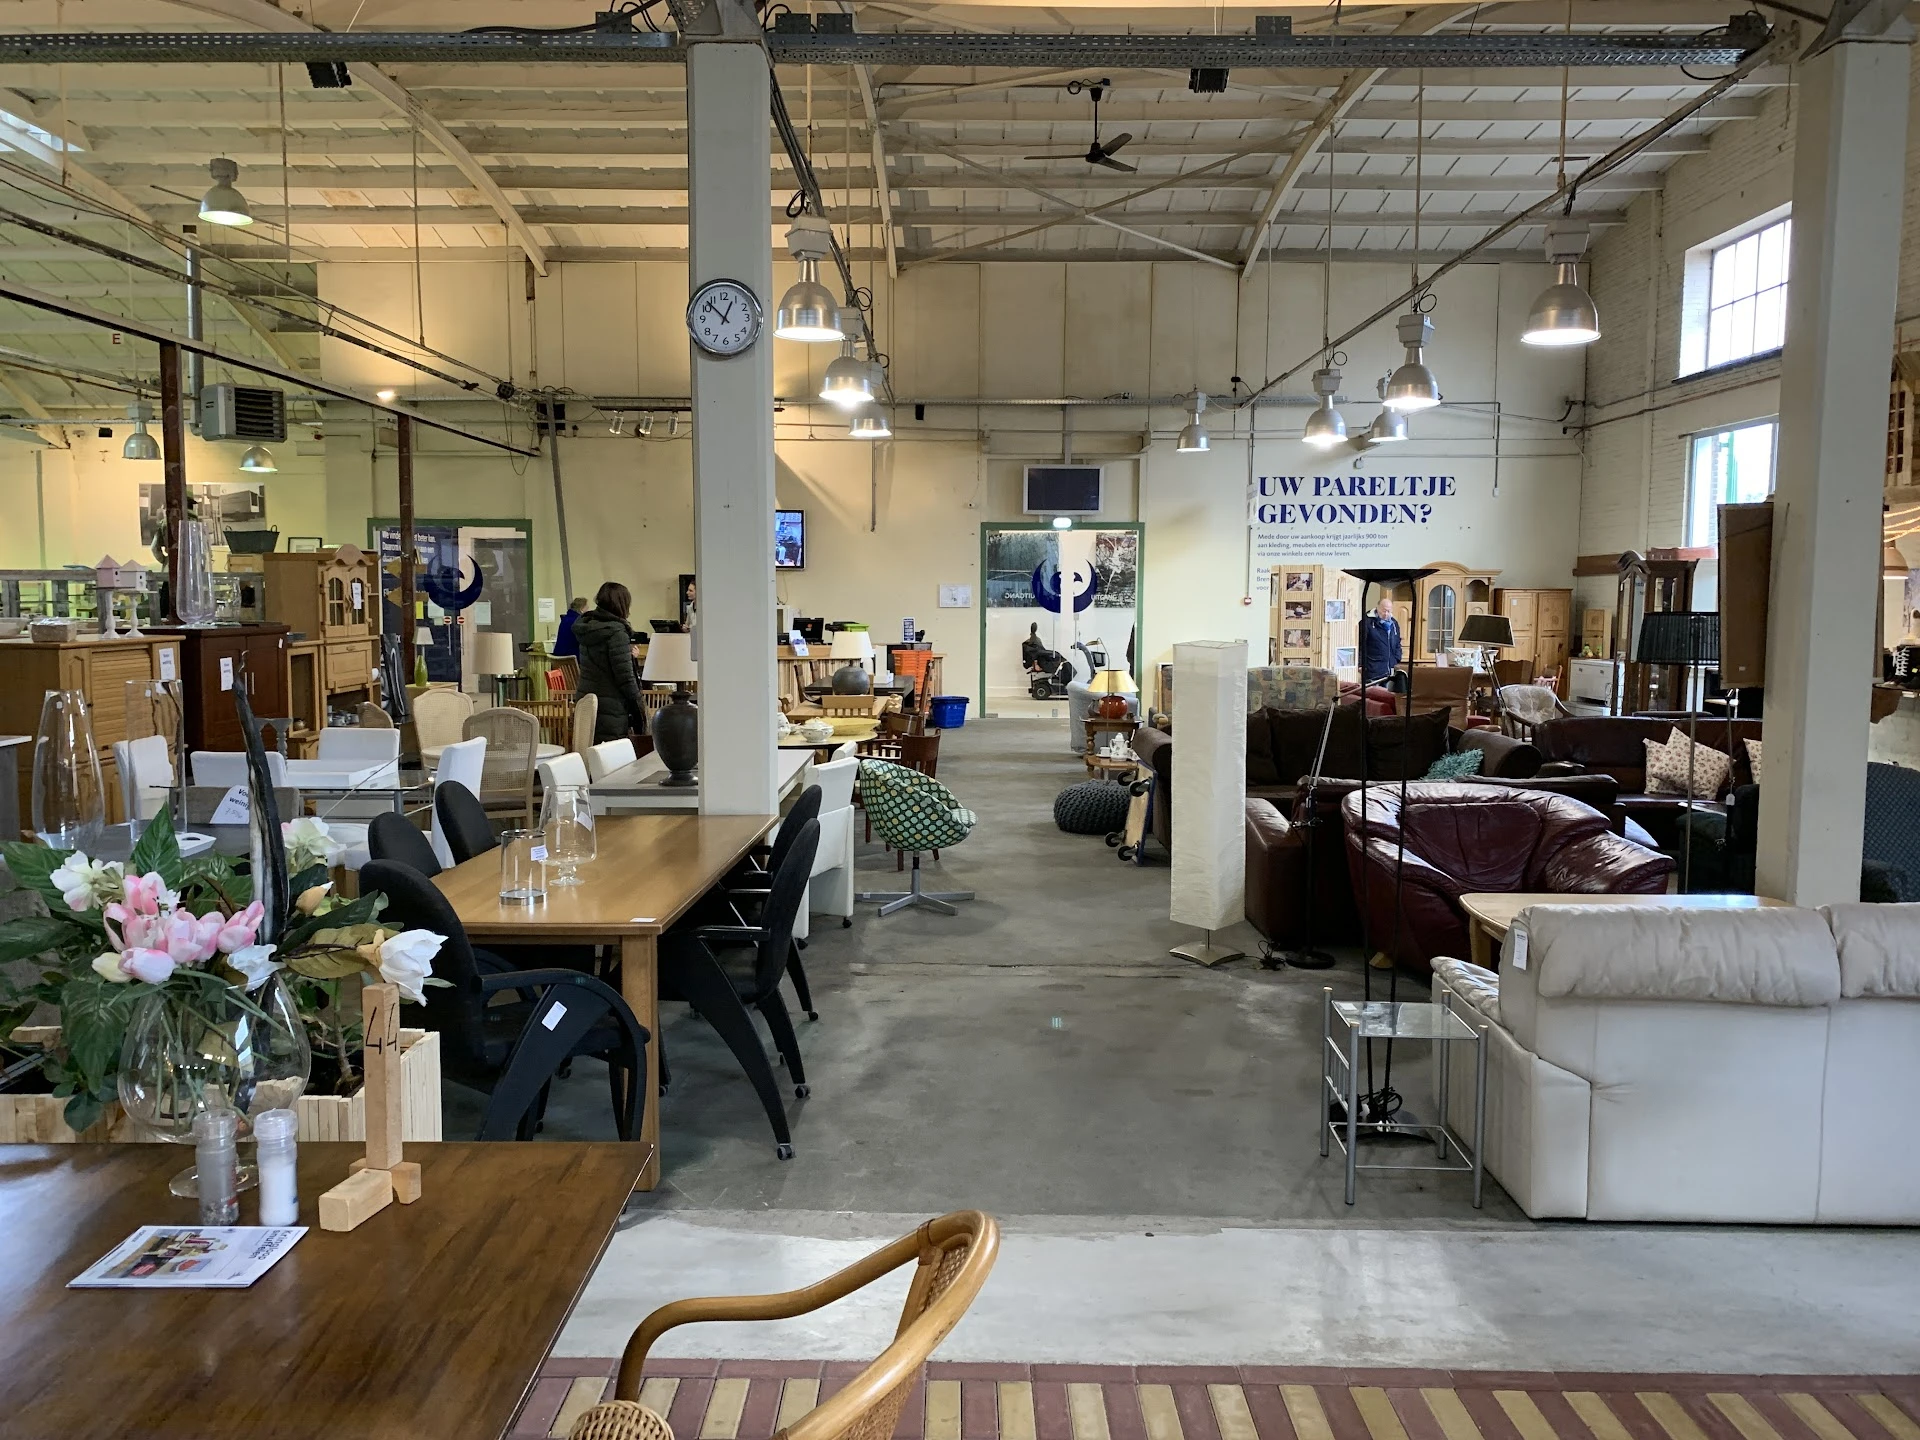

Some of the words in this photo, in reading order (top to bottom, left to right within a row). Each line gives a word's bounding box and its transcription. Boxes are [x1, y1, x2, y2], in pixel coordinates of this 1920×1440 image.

[720, 292, 729, 300] 12
[702, 304, 712, 312] 10
[741, 303, 748, 311] 2
[700, 315, 706, 323] 9
[744, 314, 750, 322] 3
[112, 334, 121, 344] E
[713, 334, 718, 342] 7
[722, 337, 729, 345] 6
[734, 334, 740, 342] 5
[1258, 476, 1305, 496] UW
[1312, 476, 1457, 496] PARELTJE
[1258, 504, 1432, 524] GEVONDEN?
[382, 530, 390, 540] We
[390, 531, 401, 540] vinde
